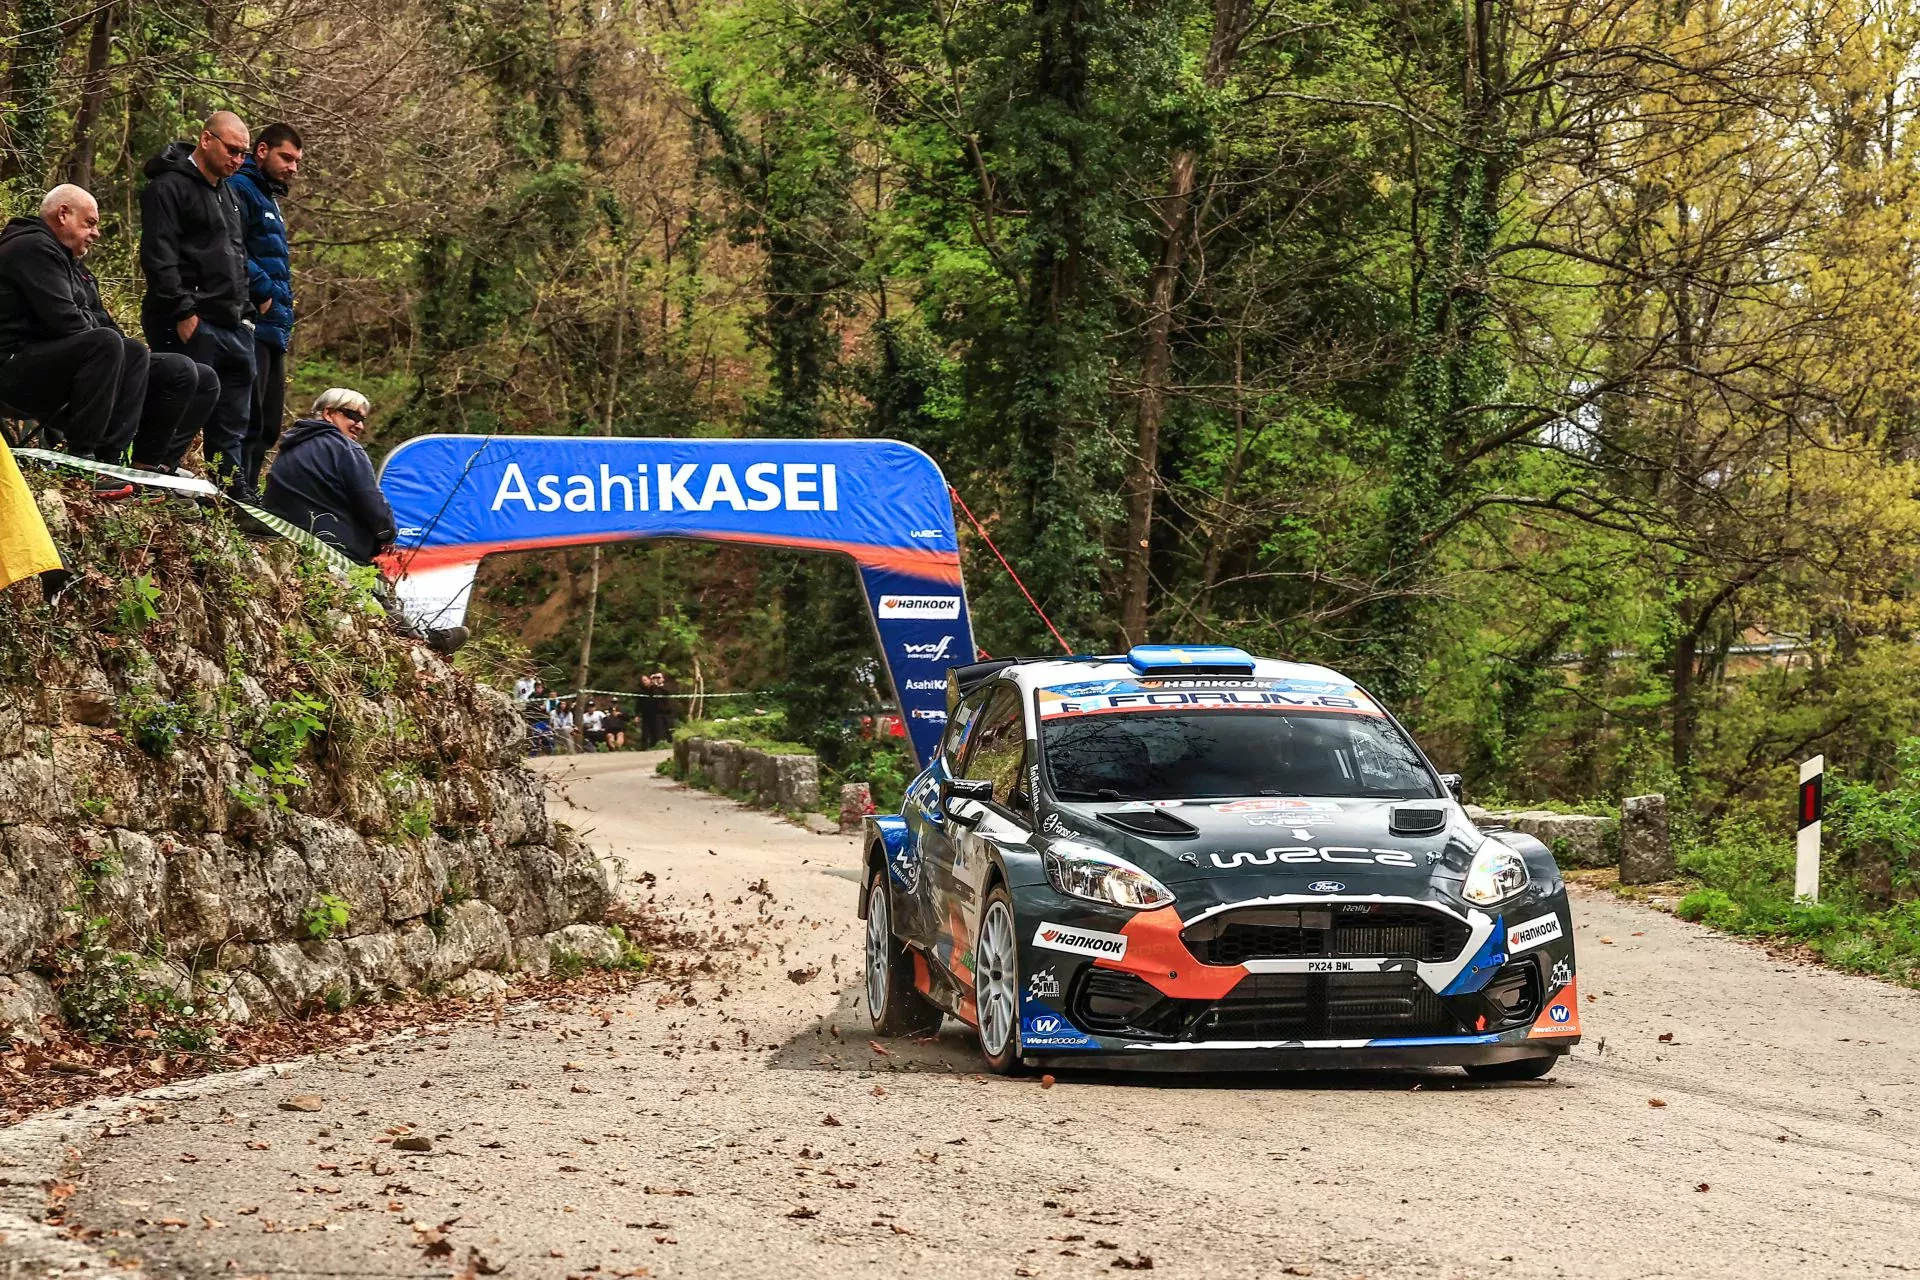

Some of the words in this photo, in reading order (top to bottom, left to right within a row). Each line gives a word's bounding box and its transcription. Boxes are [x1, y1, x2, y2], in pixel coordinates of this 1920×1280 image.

[910, 529, 943, 538] WRC
[1314, 882, 1340, 891] Ford
[1308, 962, 1333, 971] PX24
[1026, 1037, 1088, 1045] West2000.se
